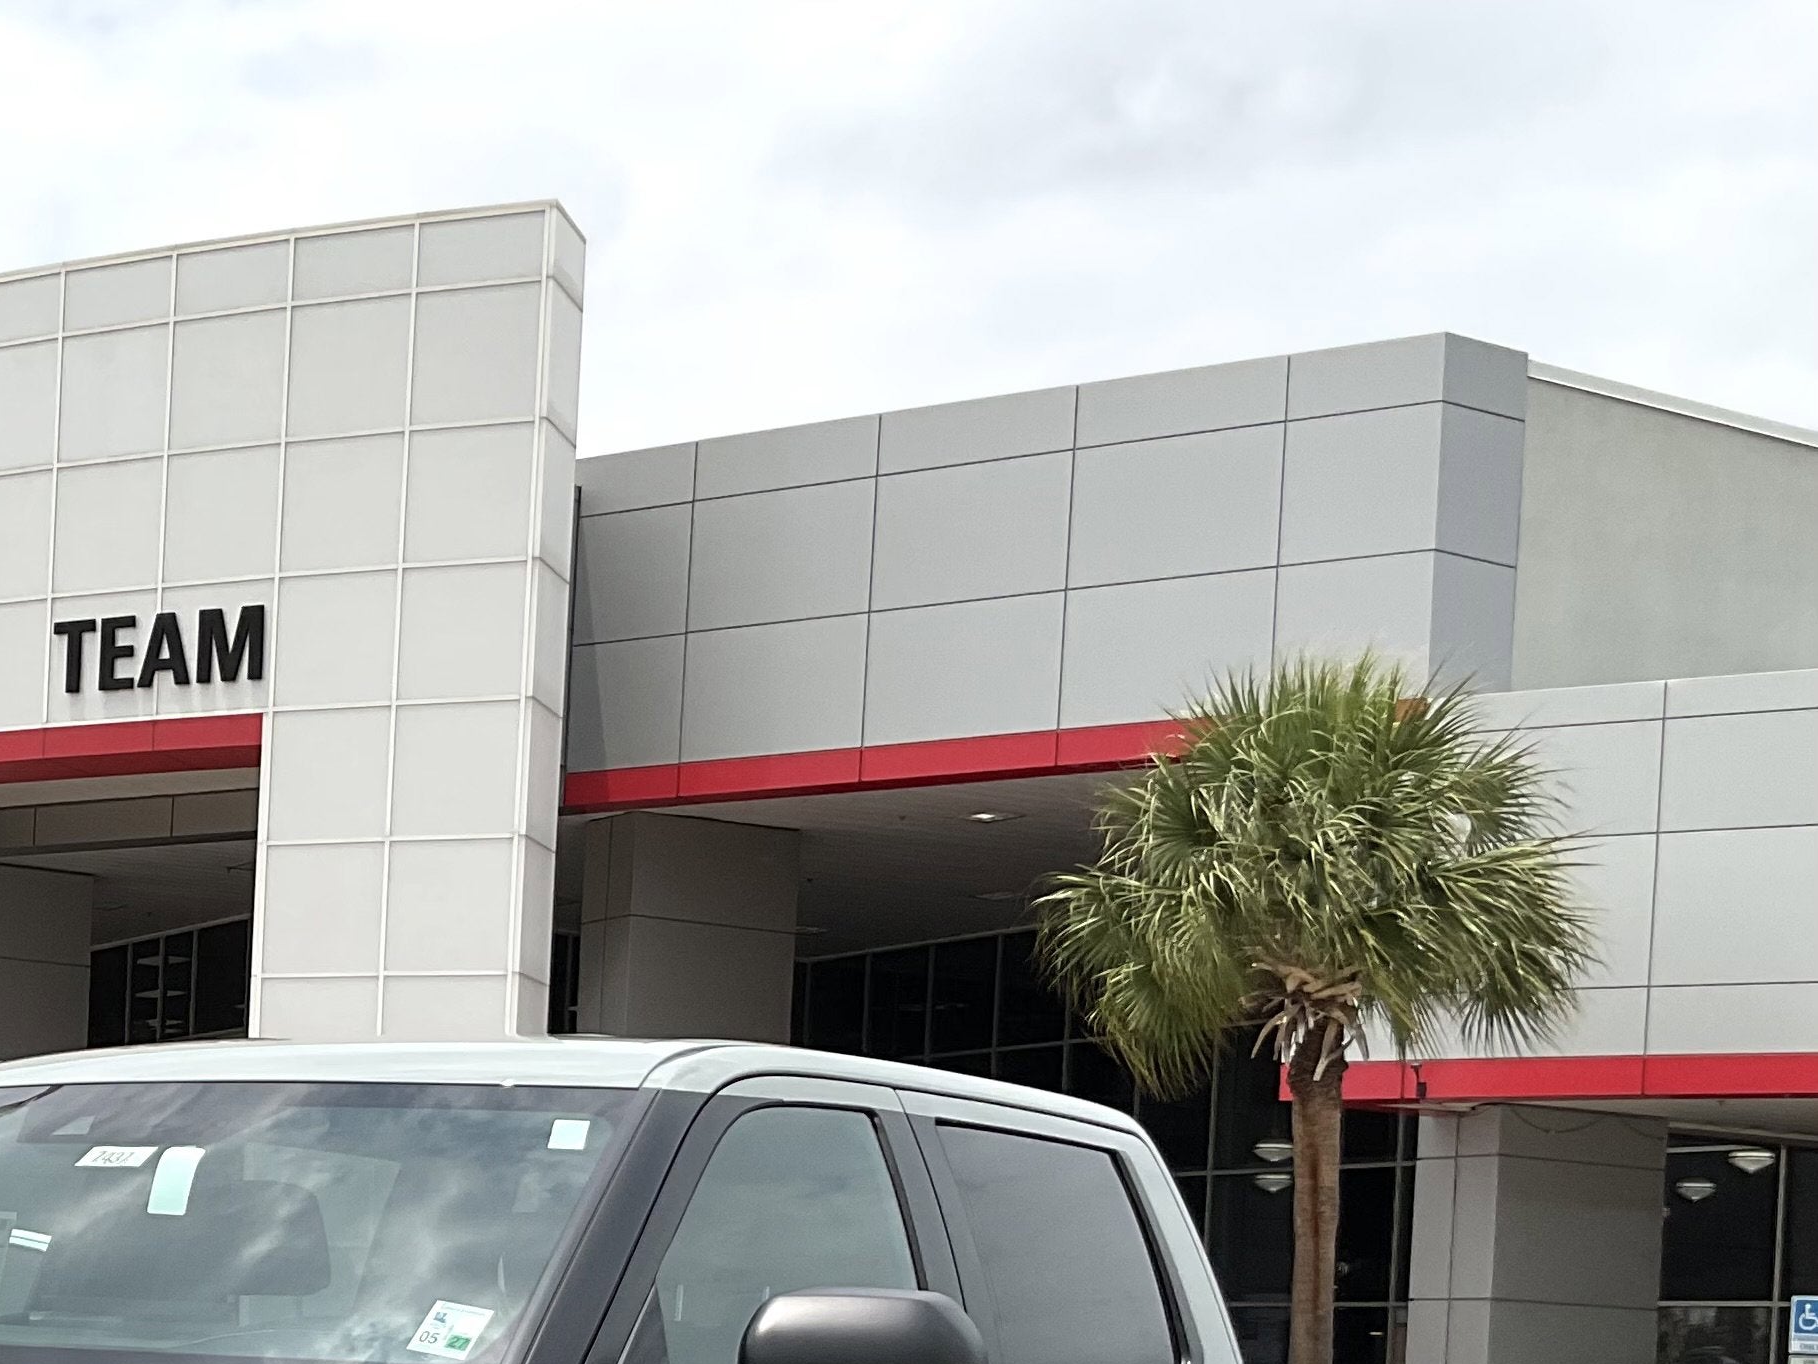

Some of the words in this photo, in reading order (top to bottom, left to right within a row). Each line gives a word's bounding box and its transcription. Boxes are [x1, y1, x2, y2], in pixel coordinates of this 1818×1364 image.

[54, 604, 264, 693] TEAM
[419, 1330, 440, 1344] 05
[448, 1334, 472, 1350] 27
